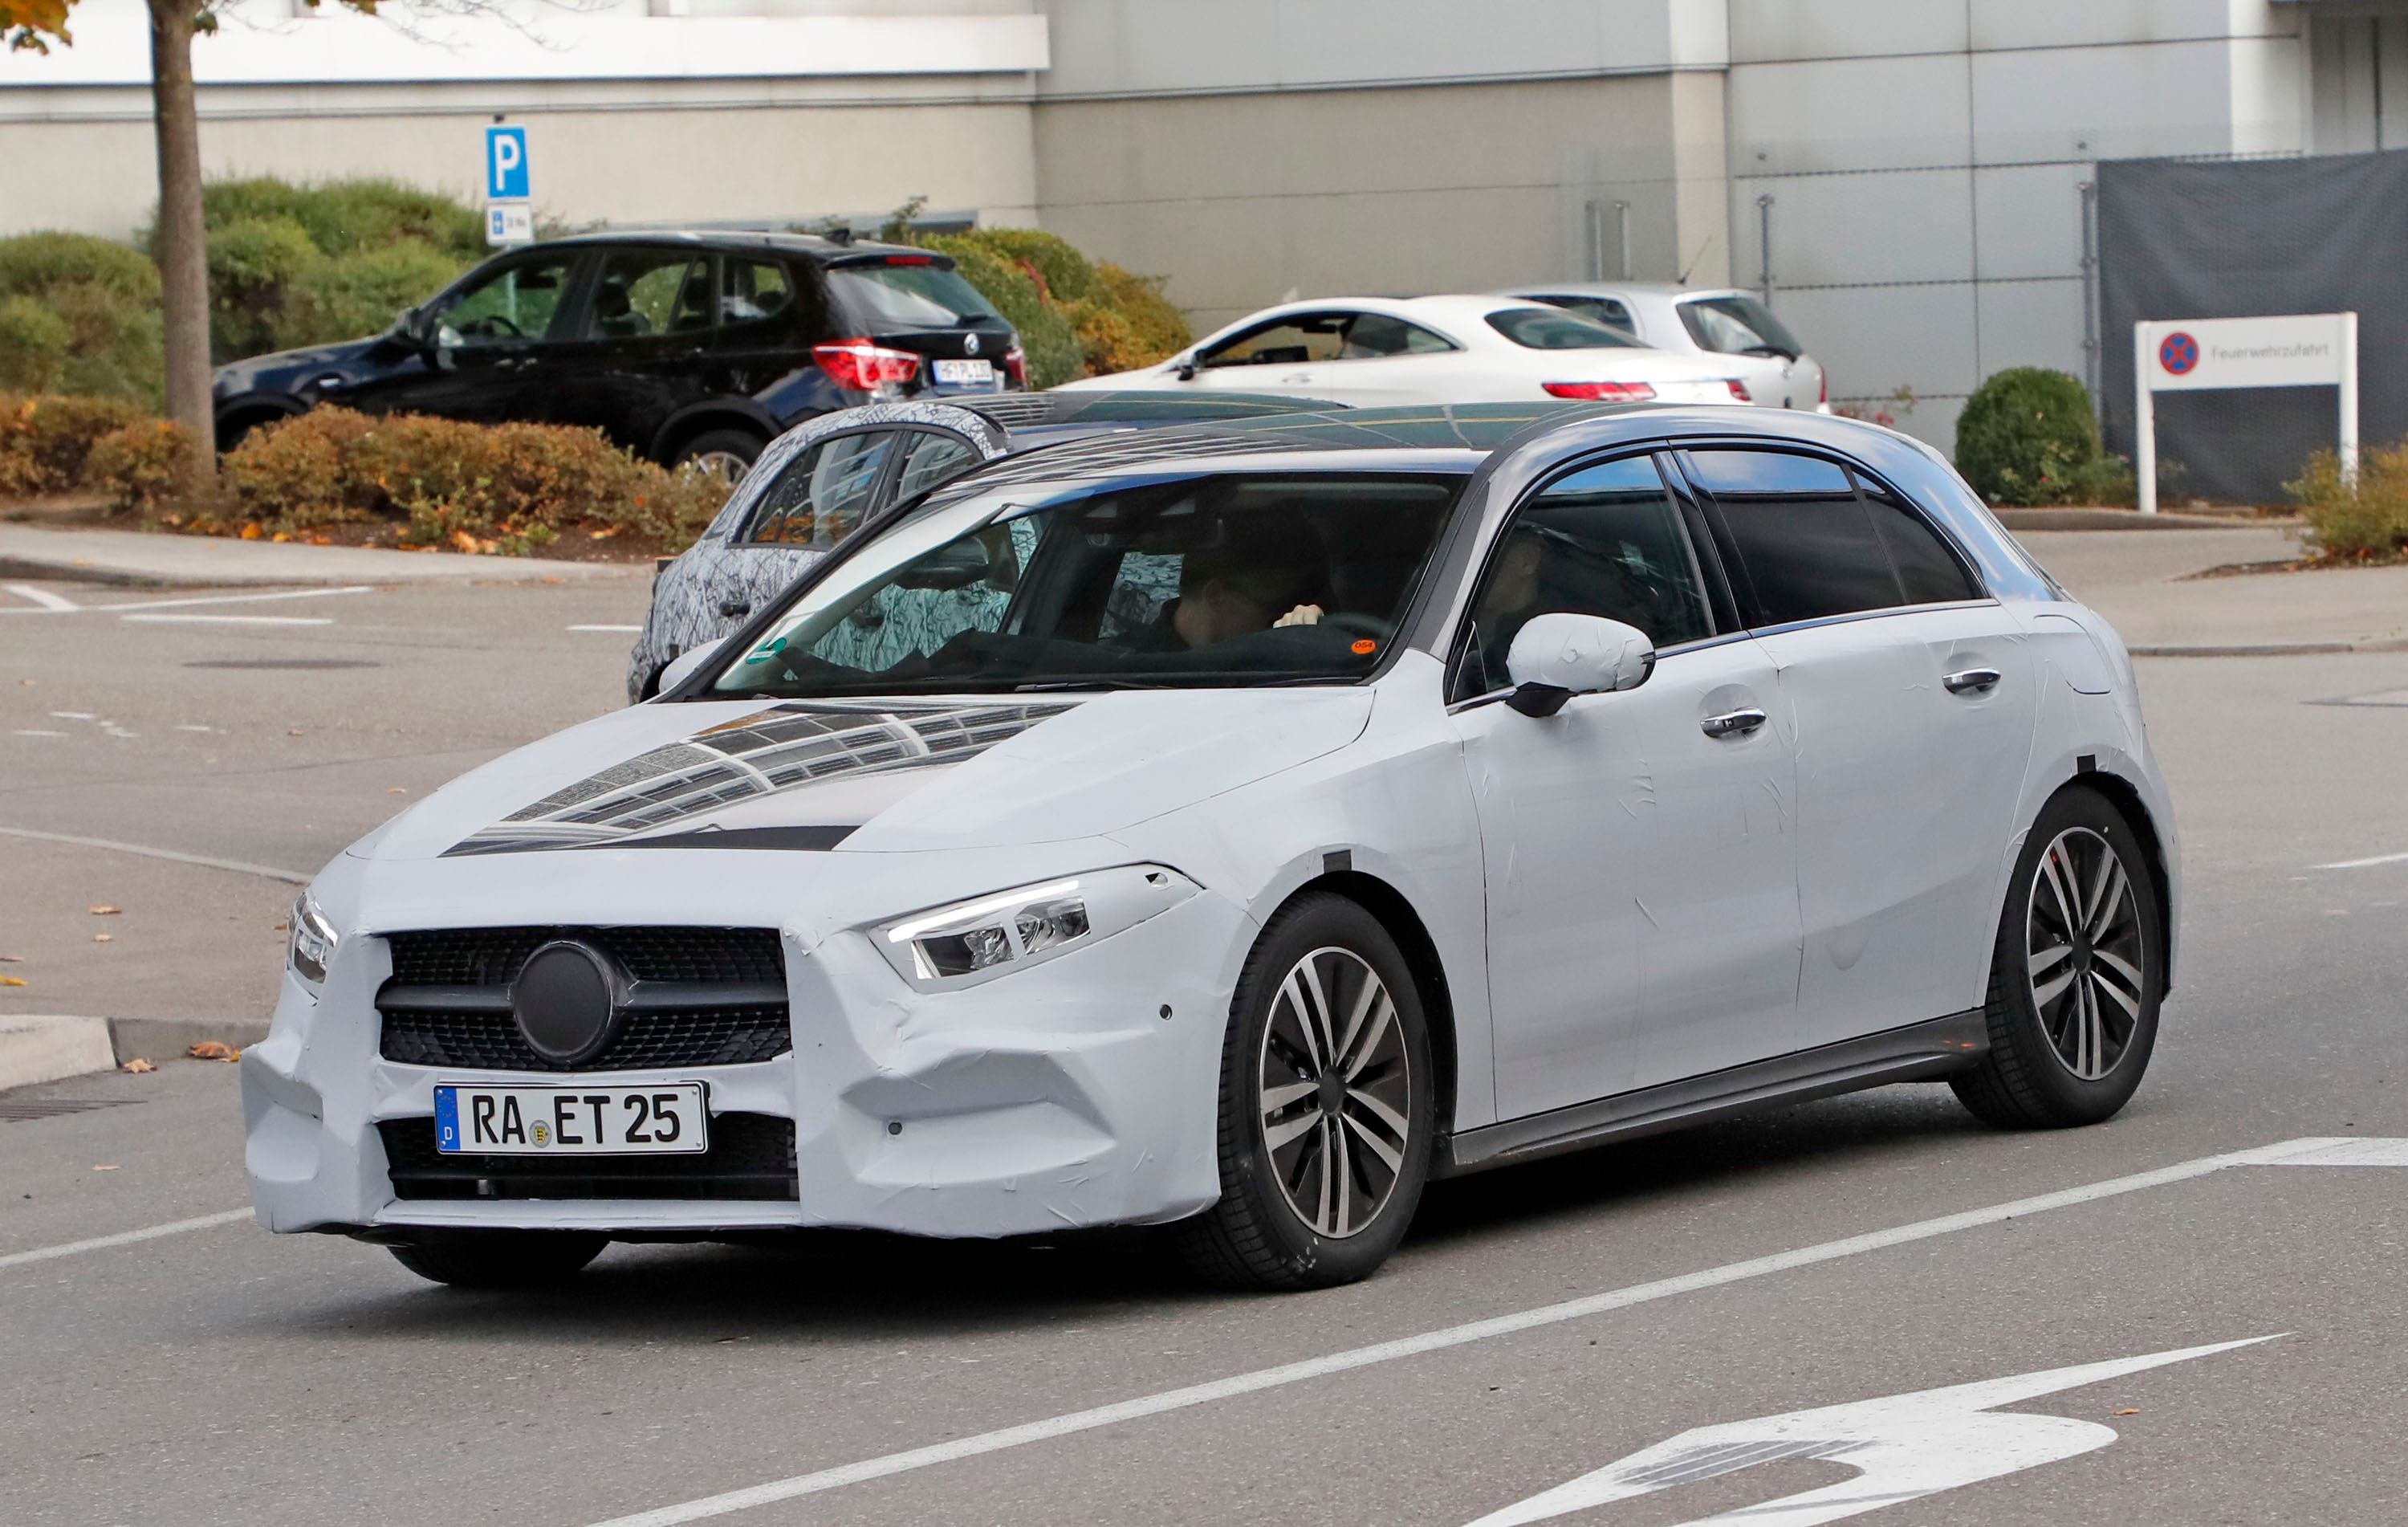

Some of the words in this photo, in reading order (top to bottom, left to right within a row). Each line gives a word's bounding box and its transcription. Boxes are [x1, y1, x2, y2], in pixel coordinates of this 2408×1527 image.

[494, 135, 520, 191] P
[2211, 344, 2329, 360] Feuerwehrzufahrt
[444, 1126, 453, 1140] D
[472, 1095, 526, 1143] RA
[554, 1096, 611, 1144] ET
[624, 1093, 681, 1142] 25
